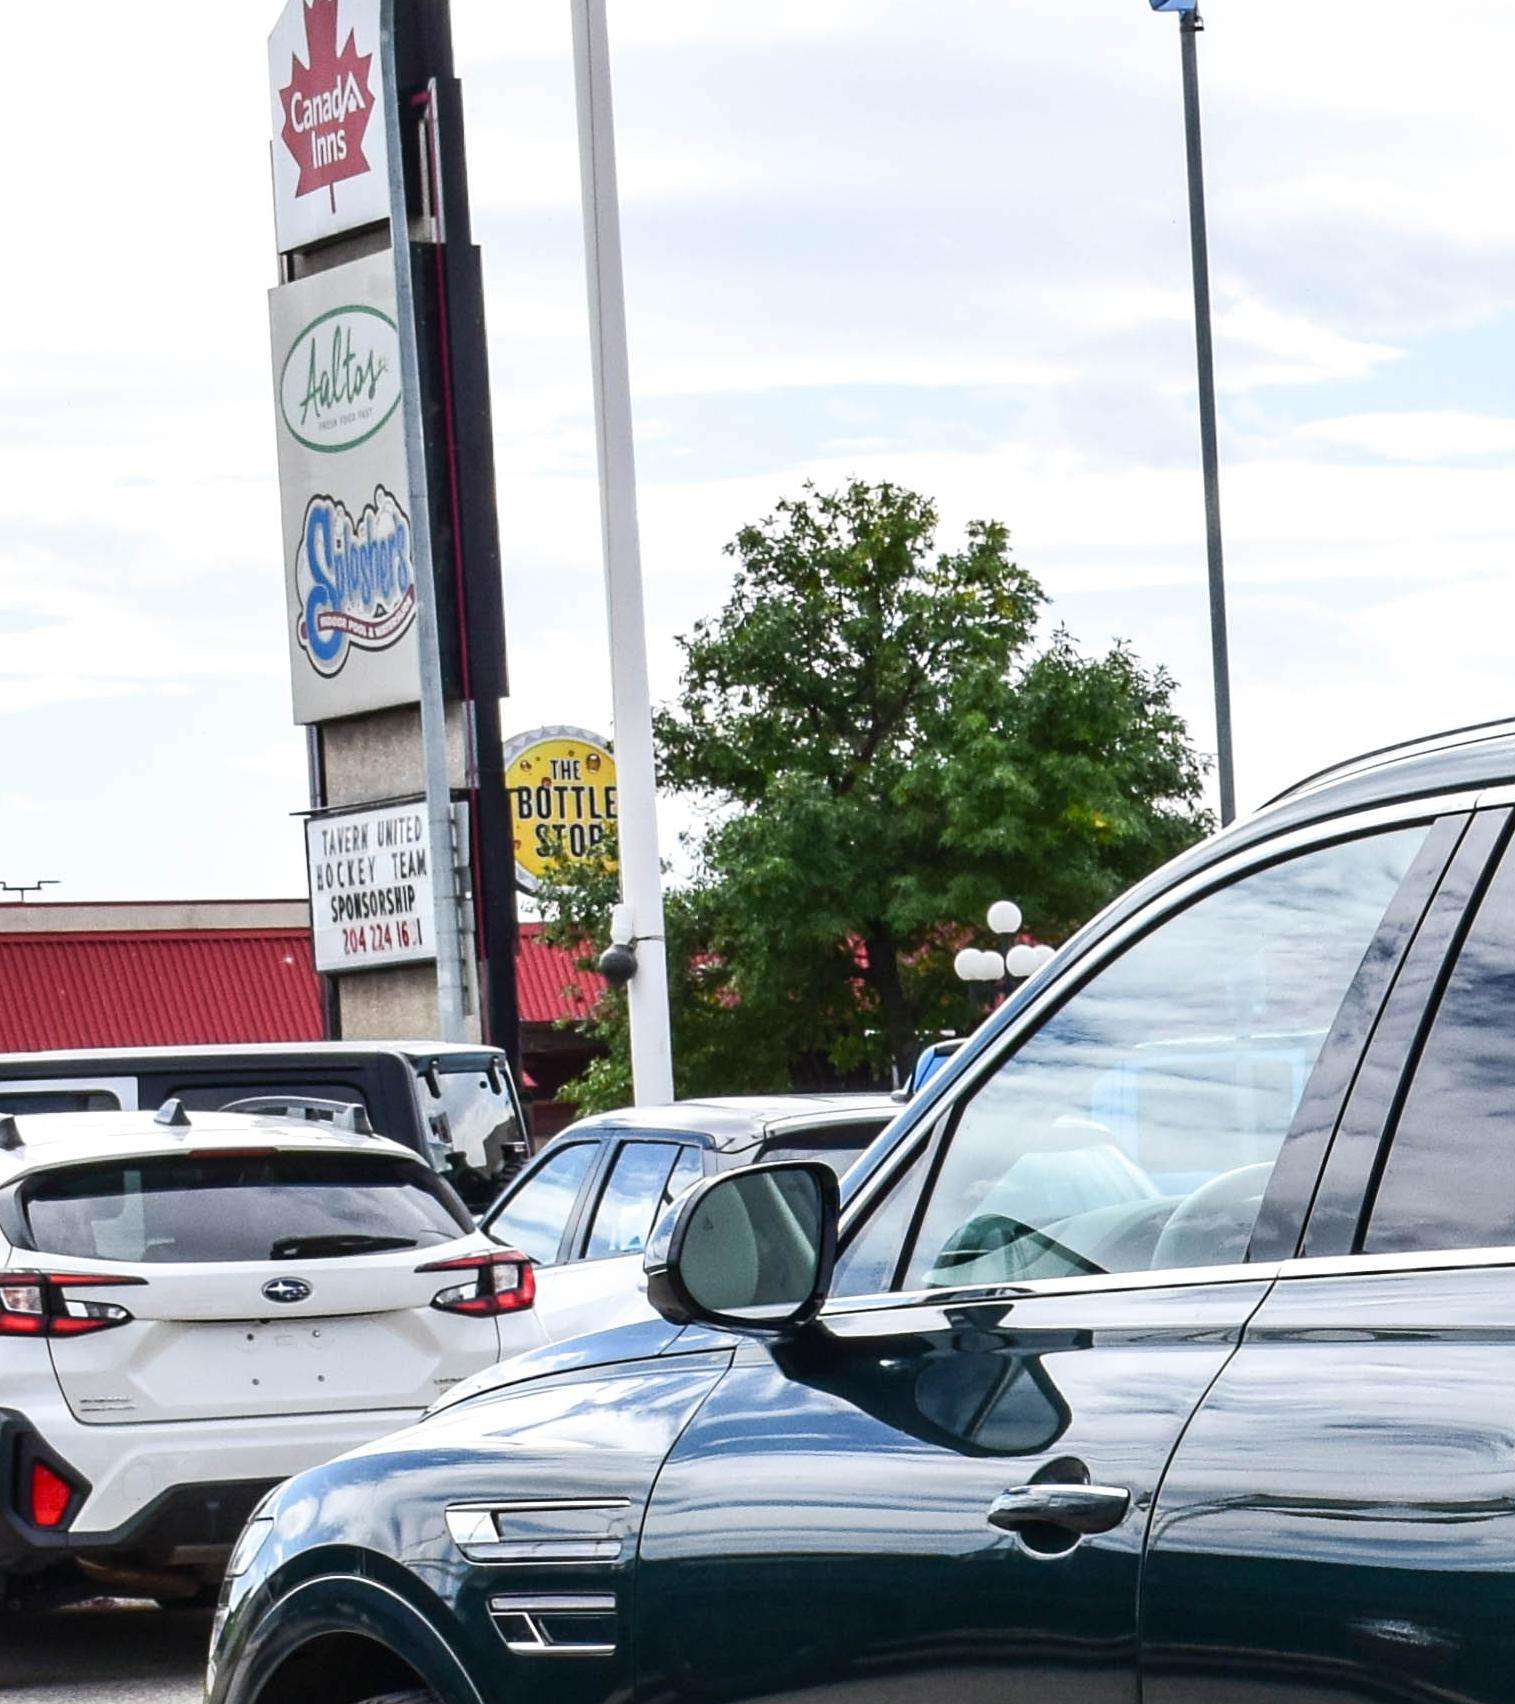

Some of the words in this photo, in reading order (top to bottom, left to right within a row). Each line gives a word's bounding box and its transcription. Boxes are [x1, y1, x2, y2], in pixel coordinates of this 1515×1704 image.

[311, 129, 347, 169] Inns
[550, 760, 581, 780] THE
[518, 786, 617, 819] BOTTLE
[322, 823, 369, 856] TAVERN
[377, 815, 422, 847] UNITED
[317, 855, 376, 891] HOCKEY
[391, 849, 427, 881] TEAM
[331, 885, 415, 923] SPONSORSHIP
[342, 925, 367, 955] 204
